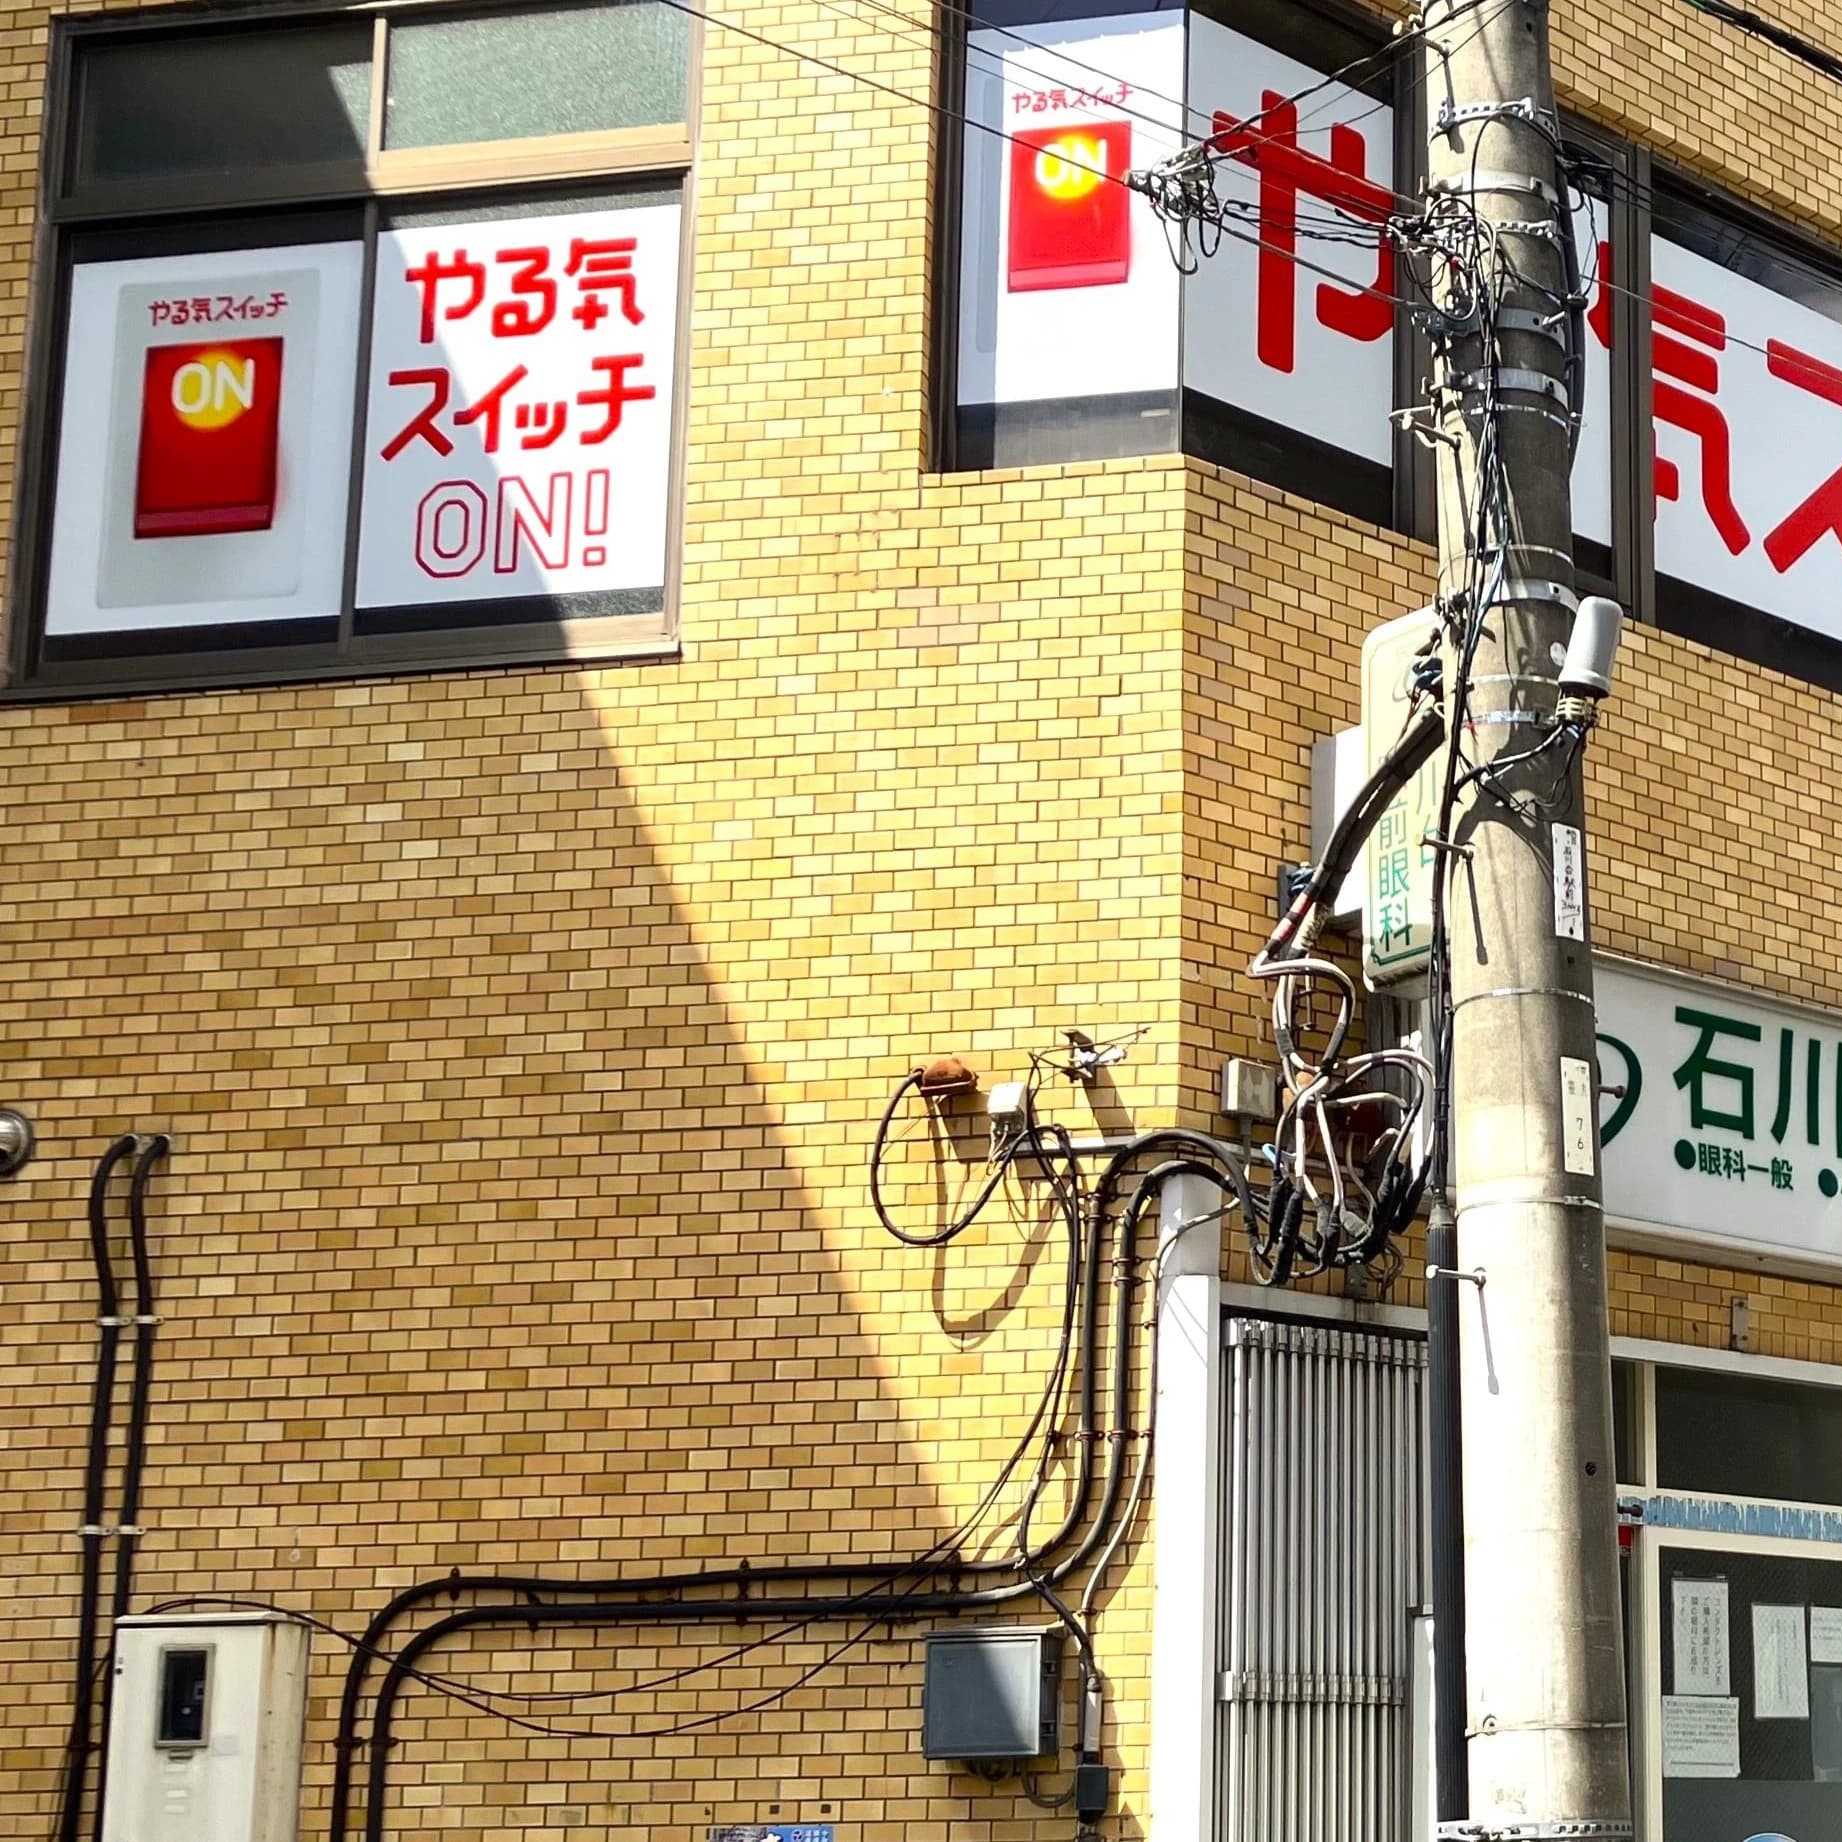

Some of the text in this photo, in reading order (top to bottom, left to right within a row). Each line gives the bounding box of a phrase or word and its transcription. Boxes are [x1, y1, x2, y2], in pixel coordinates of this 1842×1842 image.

[1012, 82, 1134, 114] やる気スイッチ
[1034, 138, 1107, 188] ON
[148, 292, 288, 327] やる気スイッチ
[406, 237, 645, 344] やる気
[171, 358, 255, 413] ON
[380, 353, 656, 462] スイッチ
[415, 468, 610, 578] ON!
